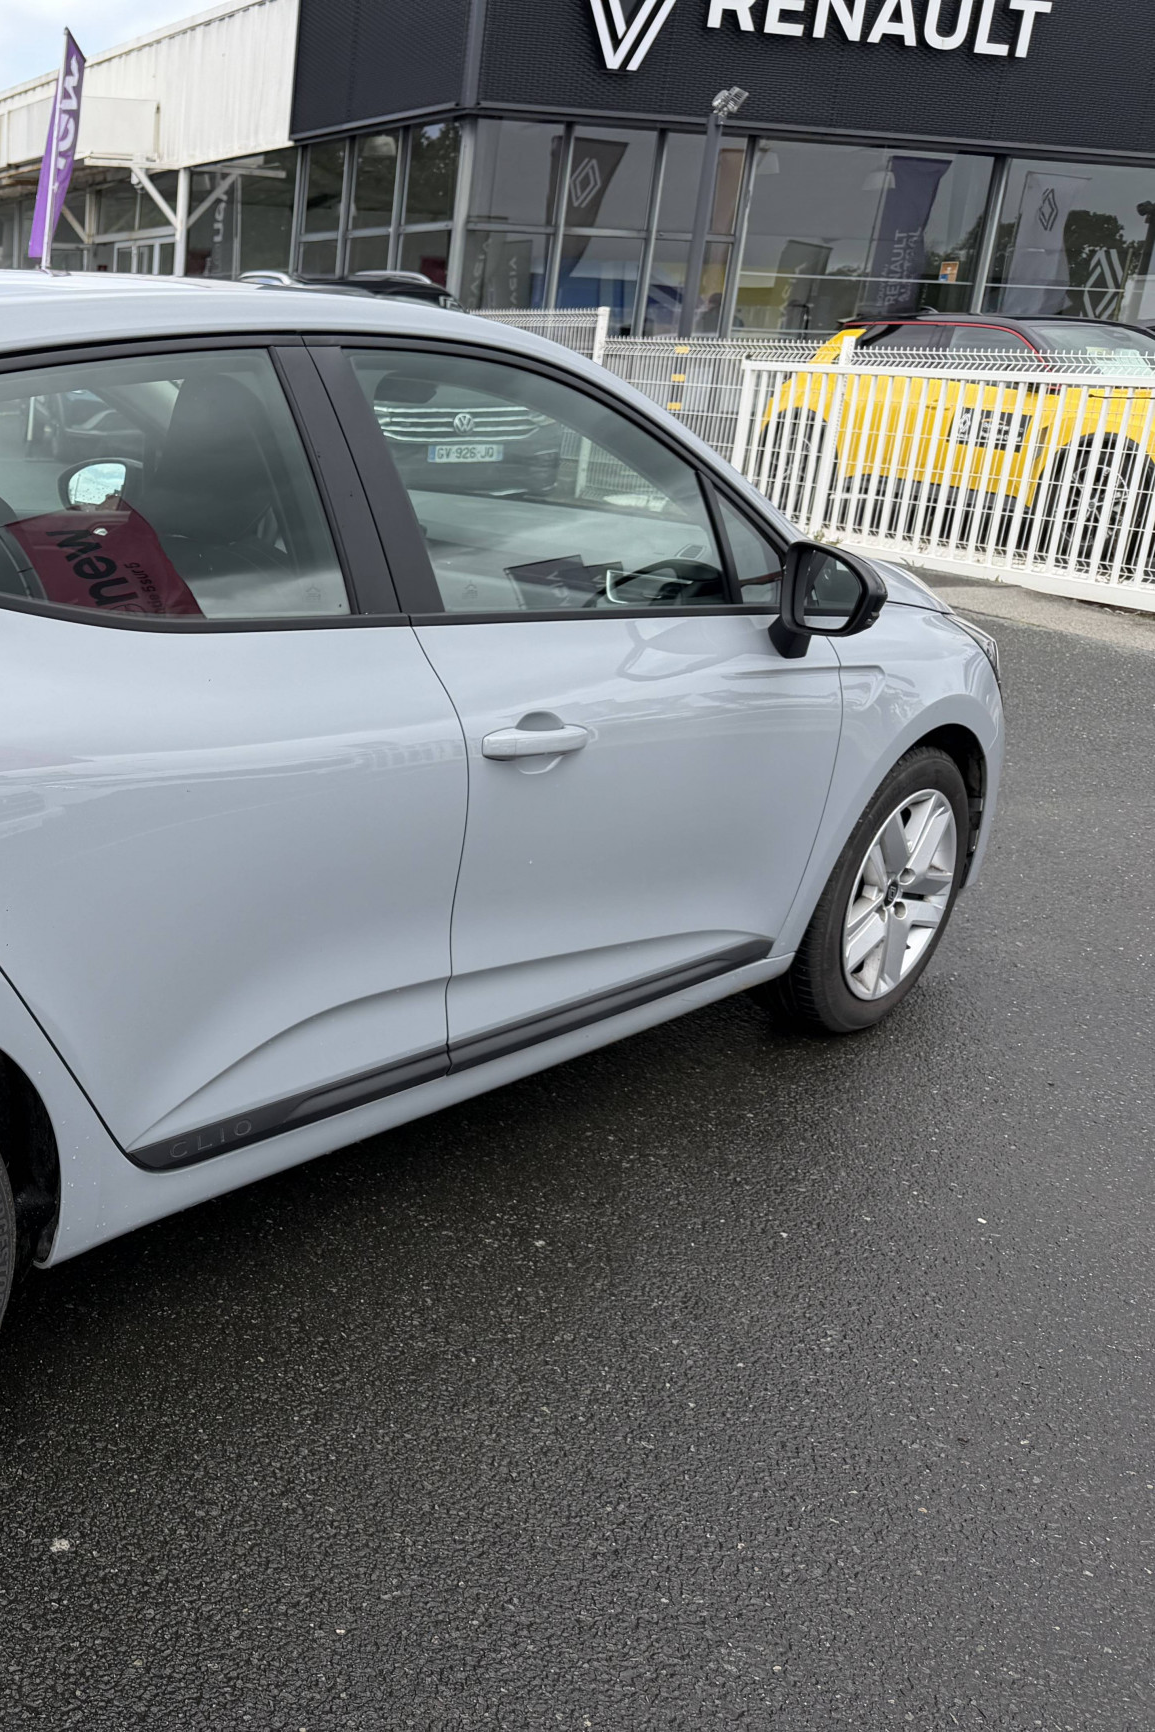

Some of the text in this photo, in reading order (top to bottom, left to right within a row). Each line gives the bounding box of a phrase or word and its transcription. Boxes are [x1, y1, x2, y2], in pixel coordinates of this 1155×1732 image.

[707, 0, 1052, 58] RENAULT
[884, 229, 908, 306] RENAULT
[170, 1118, 252, 1158] CLIO
